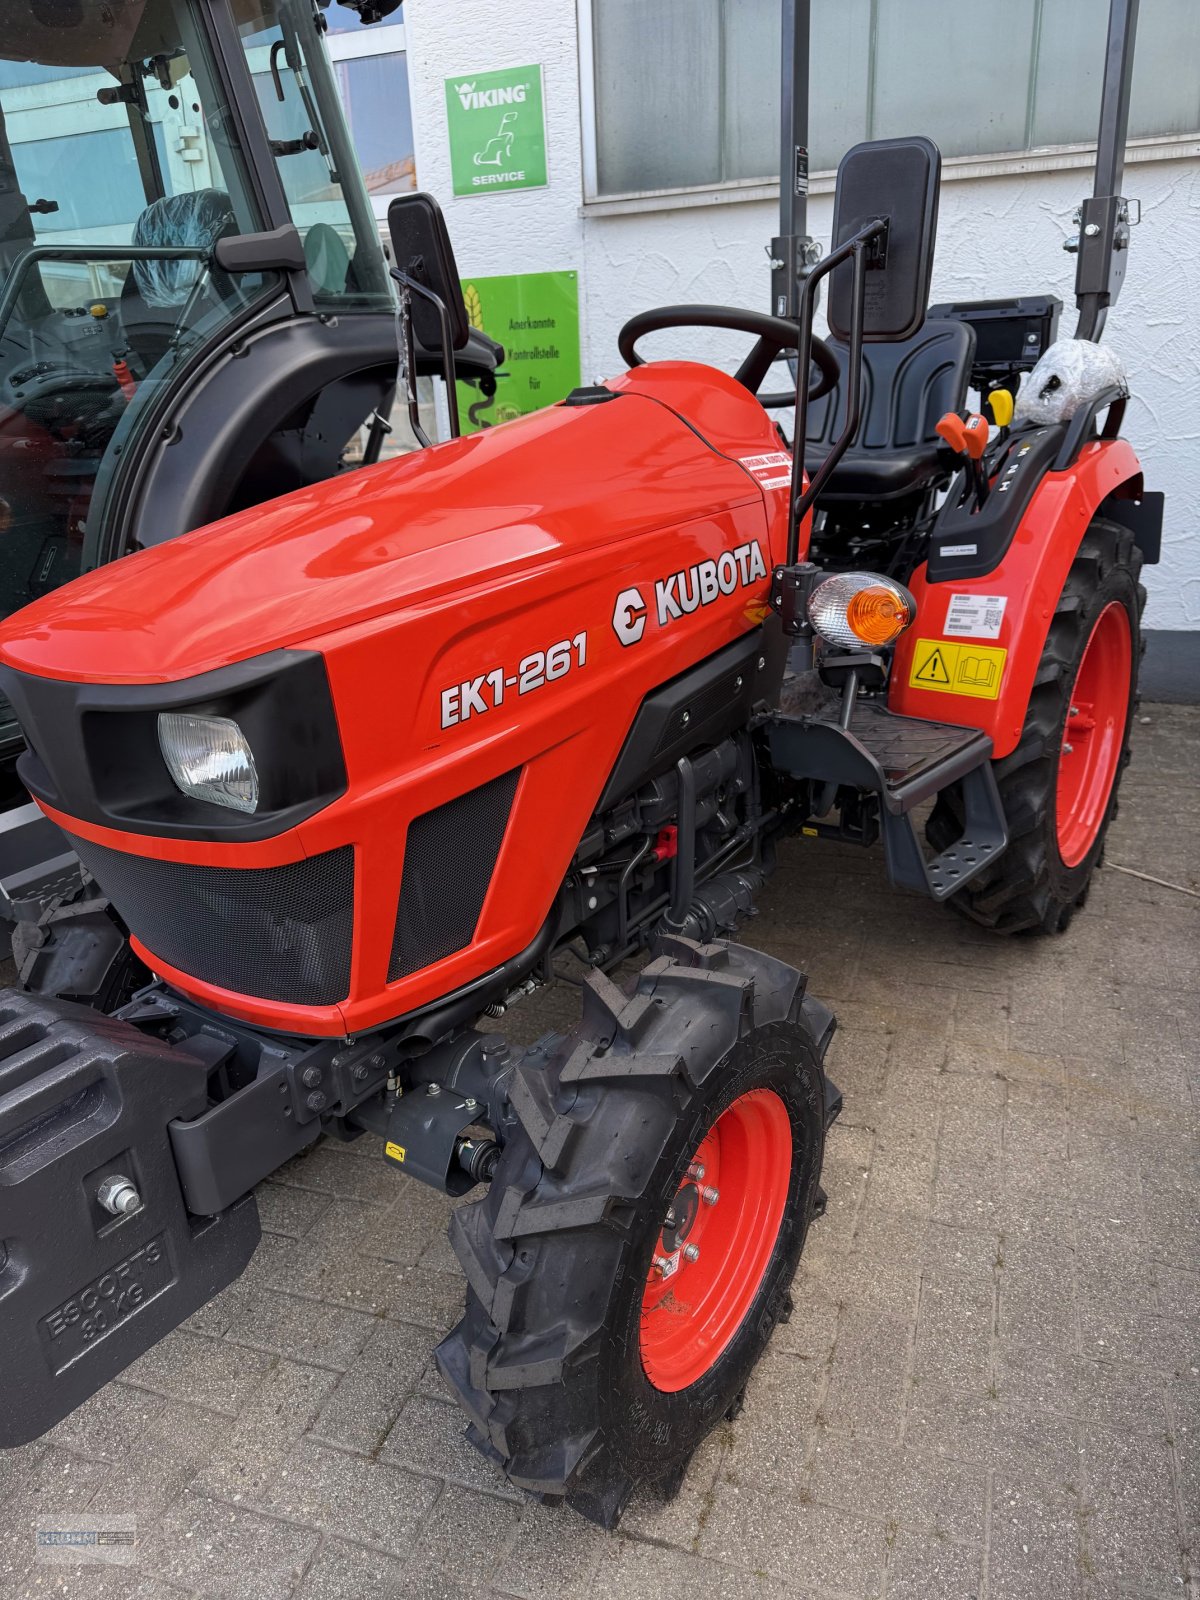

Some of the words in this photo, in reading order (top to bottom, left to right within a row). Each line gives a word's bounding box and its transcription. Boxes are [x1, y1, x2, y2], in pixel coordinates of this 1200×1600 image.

[472, 171, 525, 186] SERVICE
[508, 317, 556, 330] Anerkannte
[508, 345, 560, 361] Kontrollstelle
[529, 376, 541, 390] für
[654, 539, 767, 627] KUBOTA
[441, 630, 588, 730] EK1-261
[46, 1241, 161, 1340] ESCORTS
[111, 1282, 144, 1319] KG
